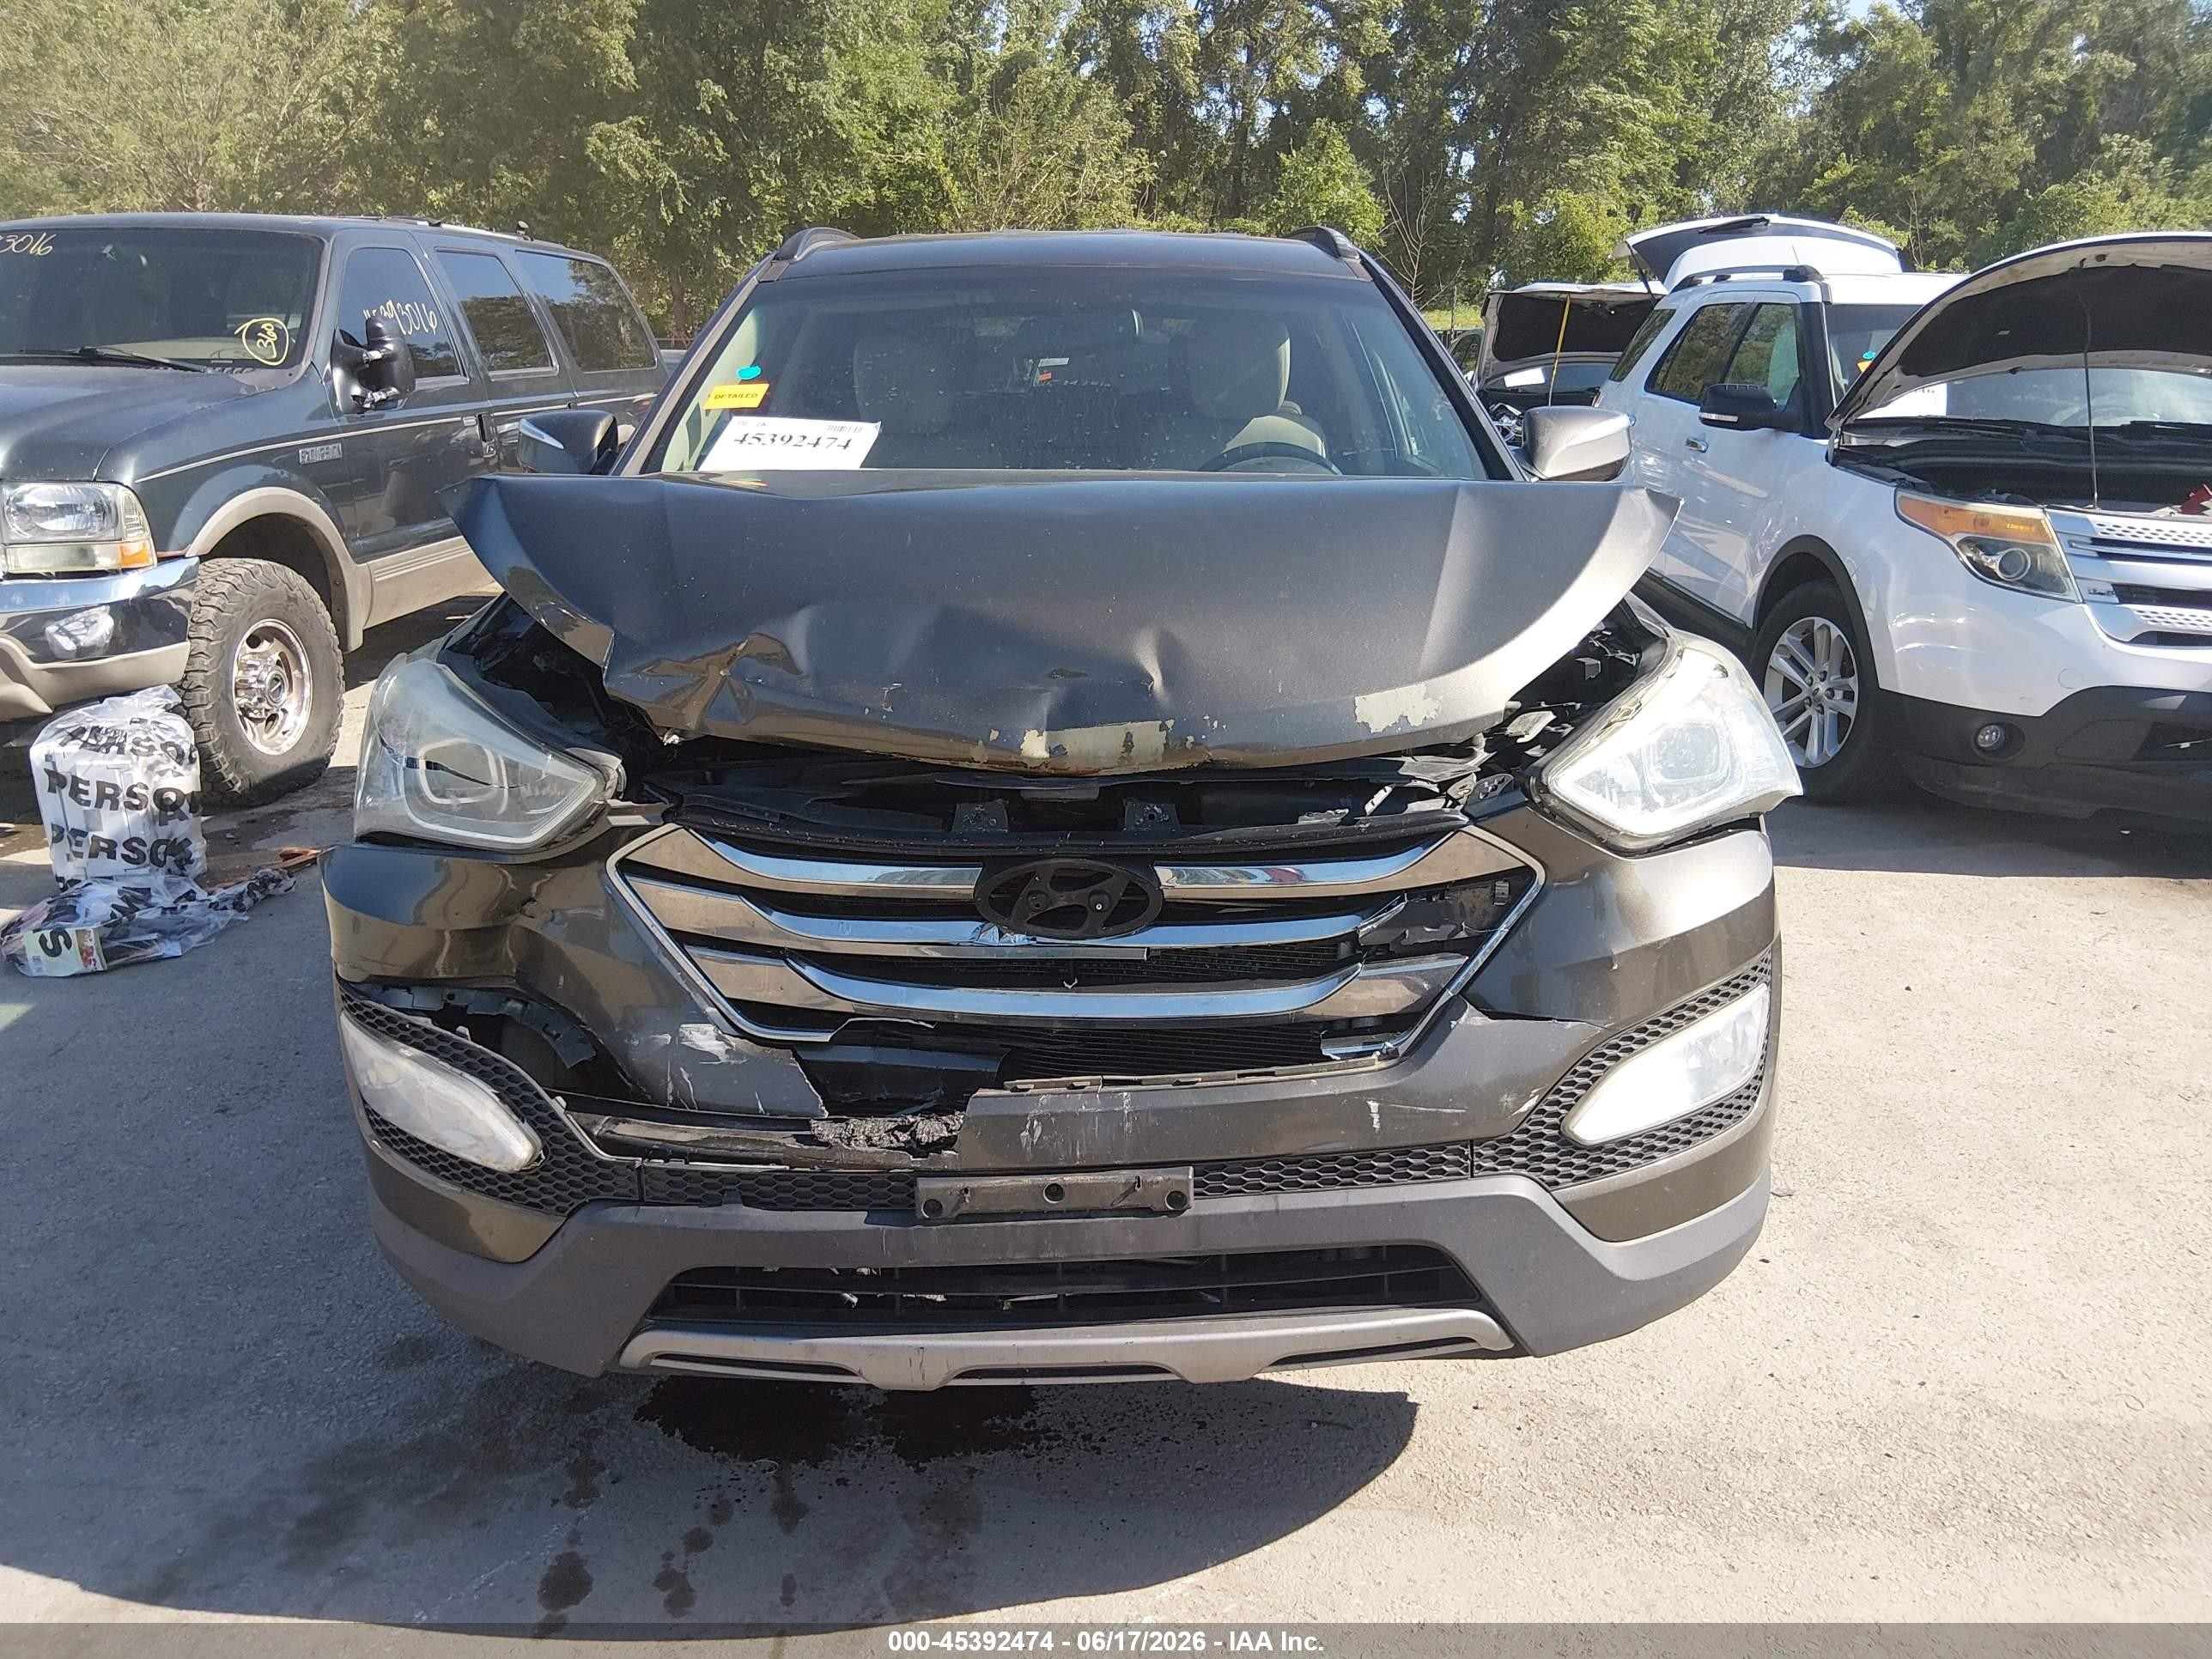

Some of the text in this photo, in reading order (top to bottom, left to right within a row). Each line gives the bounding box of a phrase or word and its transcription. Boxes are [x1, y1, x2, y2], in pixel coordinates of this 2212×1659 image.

[0, 232, 57, 256] 3016
[733, 432, 853, 451] 45392474
[58, 726, 198, 766] PERSO
[51, 822, 194, 870] PERSO
